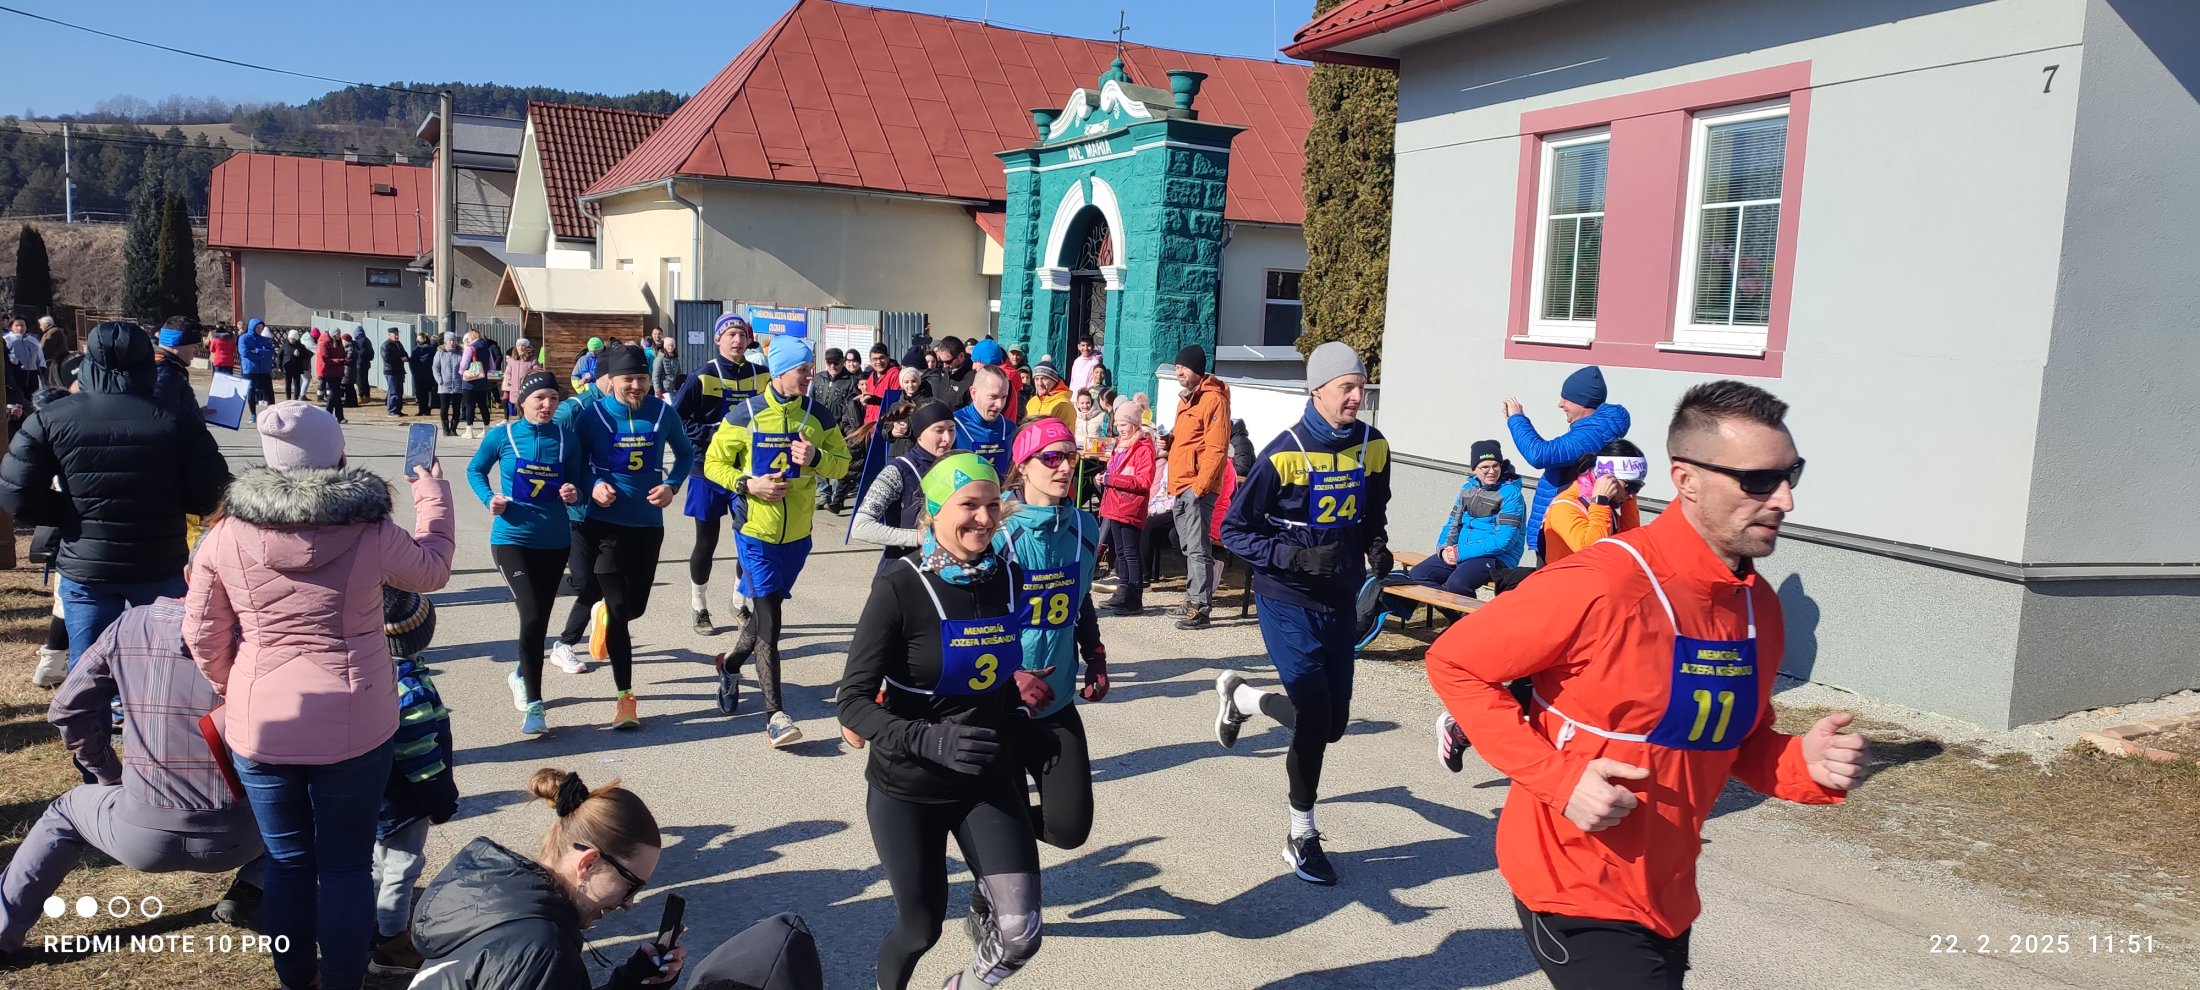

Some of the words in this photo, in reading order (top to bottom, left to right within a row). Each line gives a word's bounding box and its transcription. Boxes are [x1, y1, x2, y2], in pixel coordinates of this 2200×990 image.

[2043, 64, 2060, 94] 7
[1068, 146, 1084, 160] AVE
[1085, 139, 1112, 158] MARIA
[627, 451, 643, 471] 5
[770, 452, 790, 473] 4
[529, 478, 546, 498] 7
[1316, 494, 1357, 523] 24
[1029, 593, 1069, 625] 18
[968, 653, 998, 690] 3
[1688, 689, 1735, 743] 11
